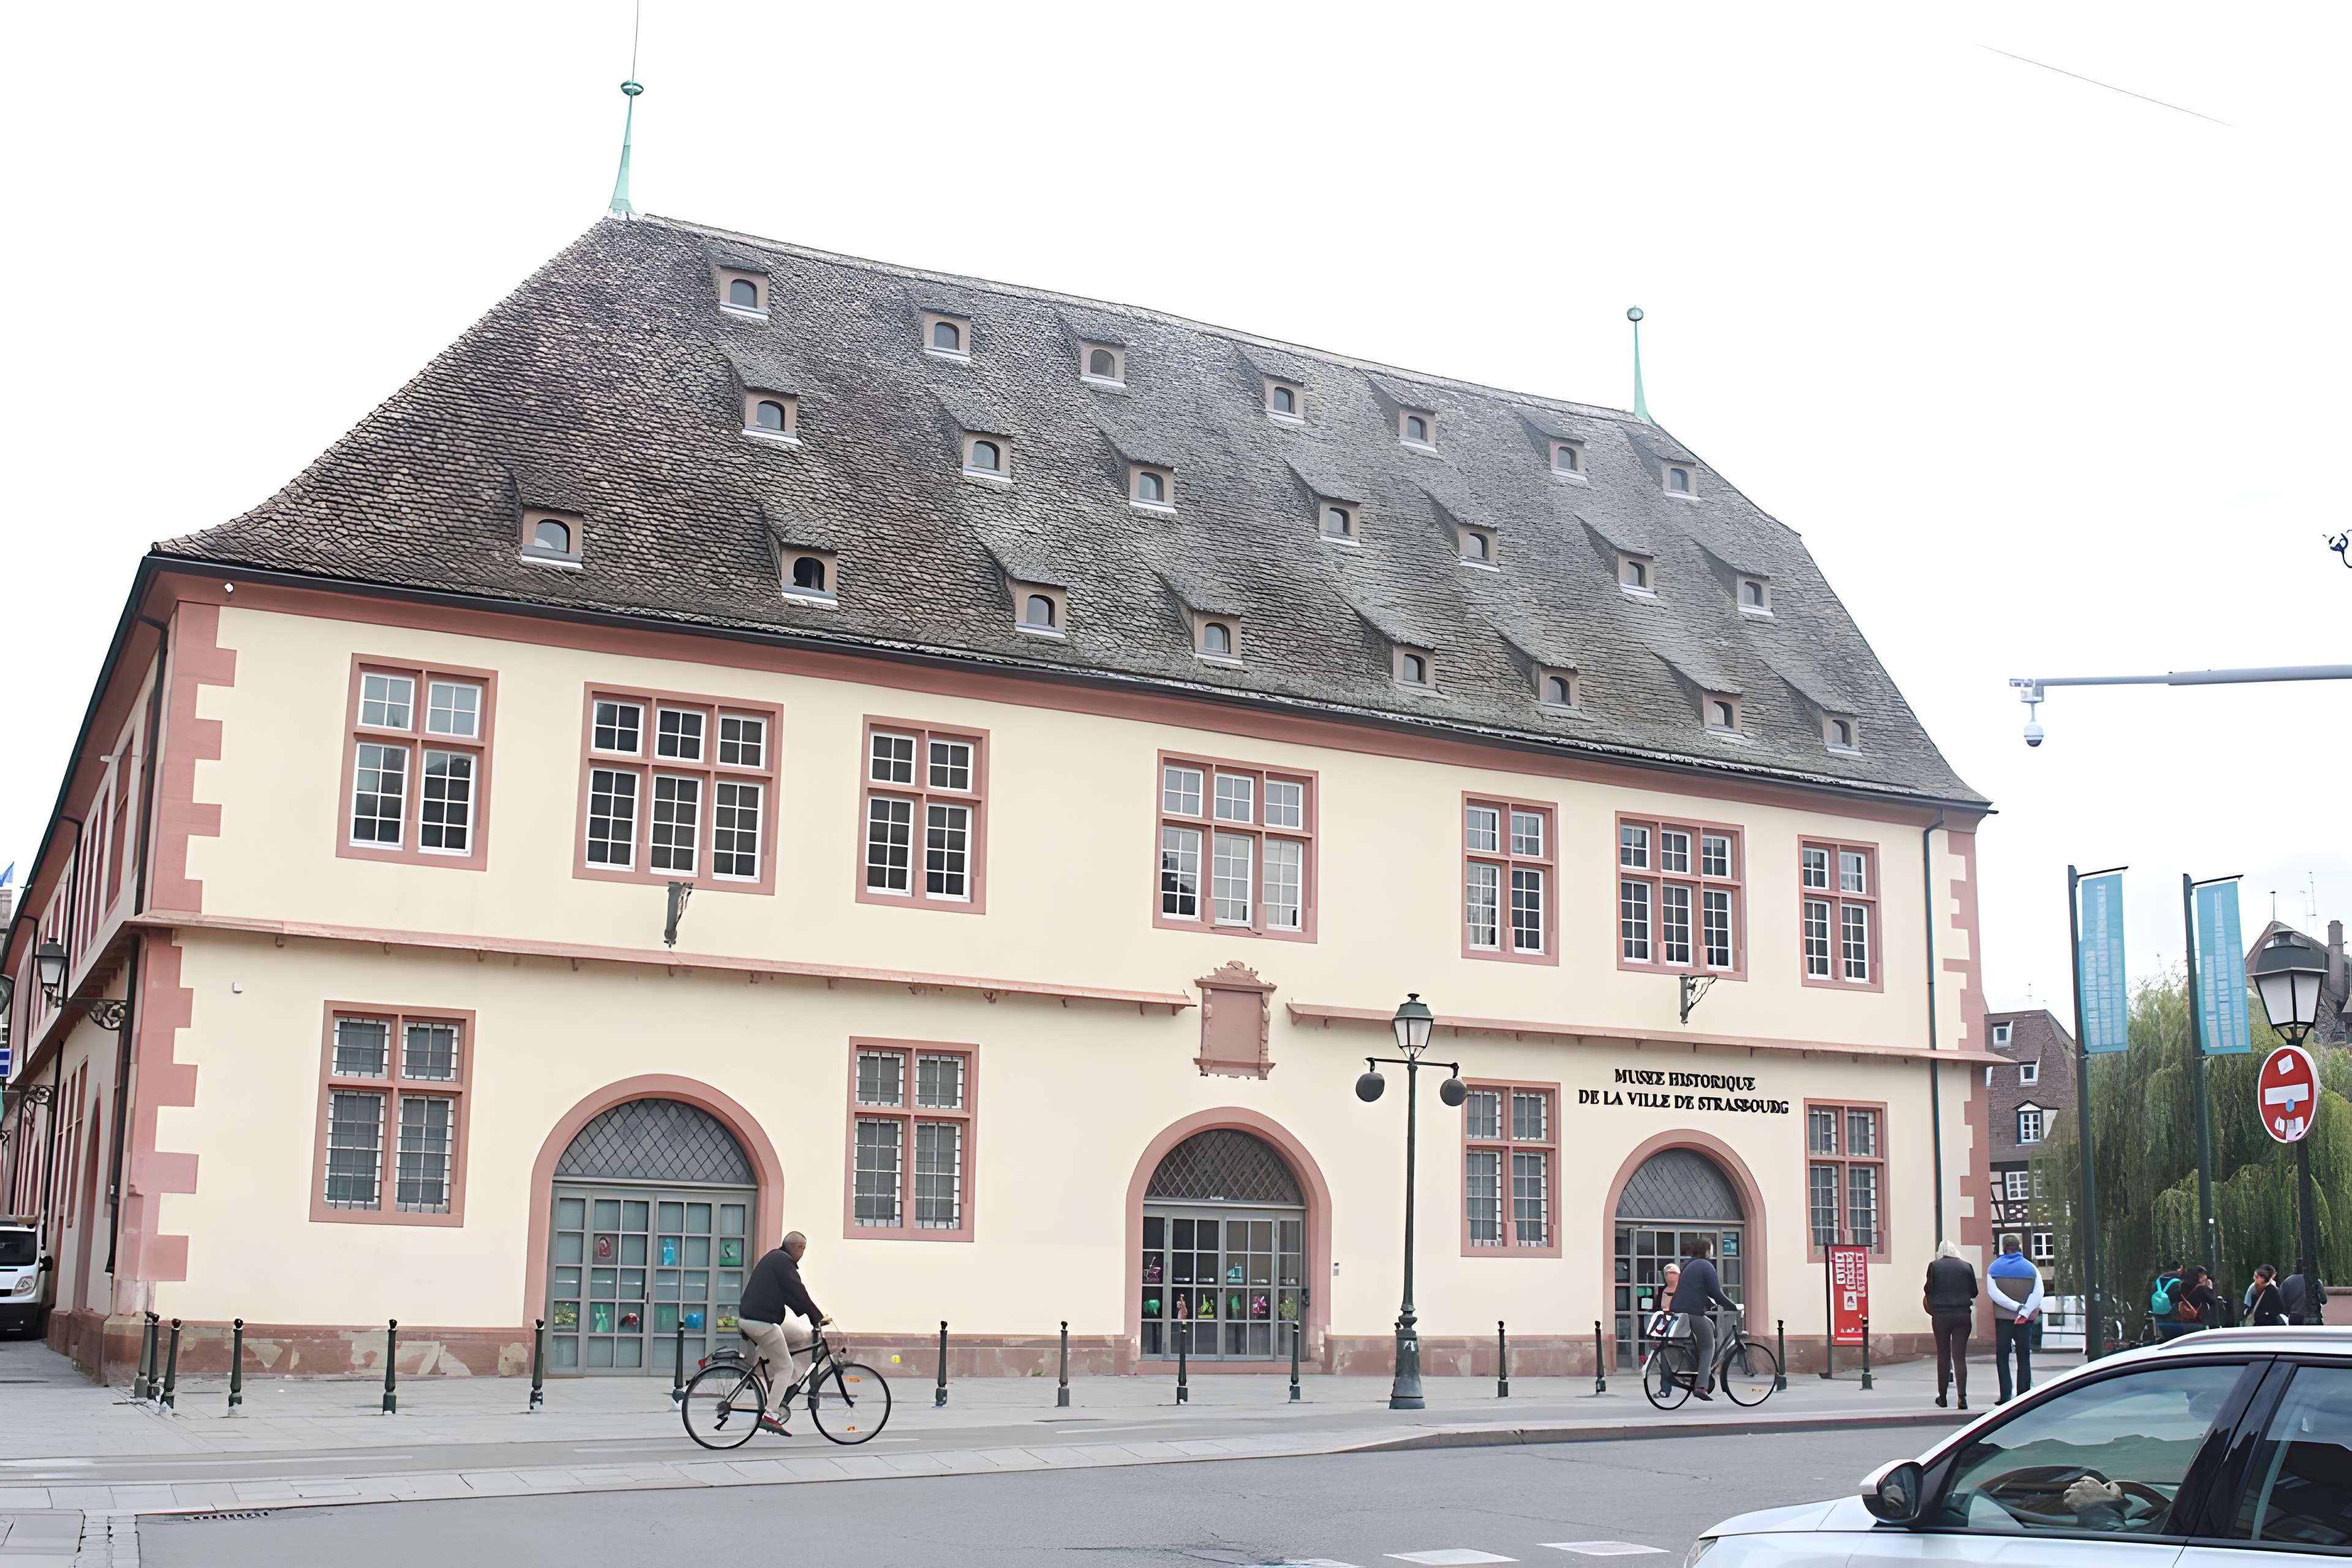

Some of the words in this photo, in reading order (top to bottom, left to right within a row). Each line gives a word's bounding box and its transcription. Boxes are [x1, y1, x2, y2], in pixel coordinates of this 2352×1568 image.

[1668, 1072, 1756, 1093] HISTORIQUE
[1578, 1089, 1600, 1104] DE
[1603, 1090, 1623, 1106] LA
[1627, 1091, 1670, 1108] VILLE
[1674, 1095, 1694, 1110] DE
[1698, 1096, 1789, 1114] STRASBOURG
